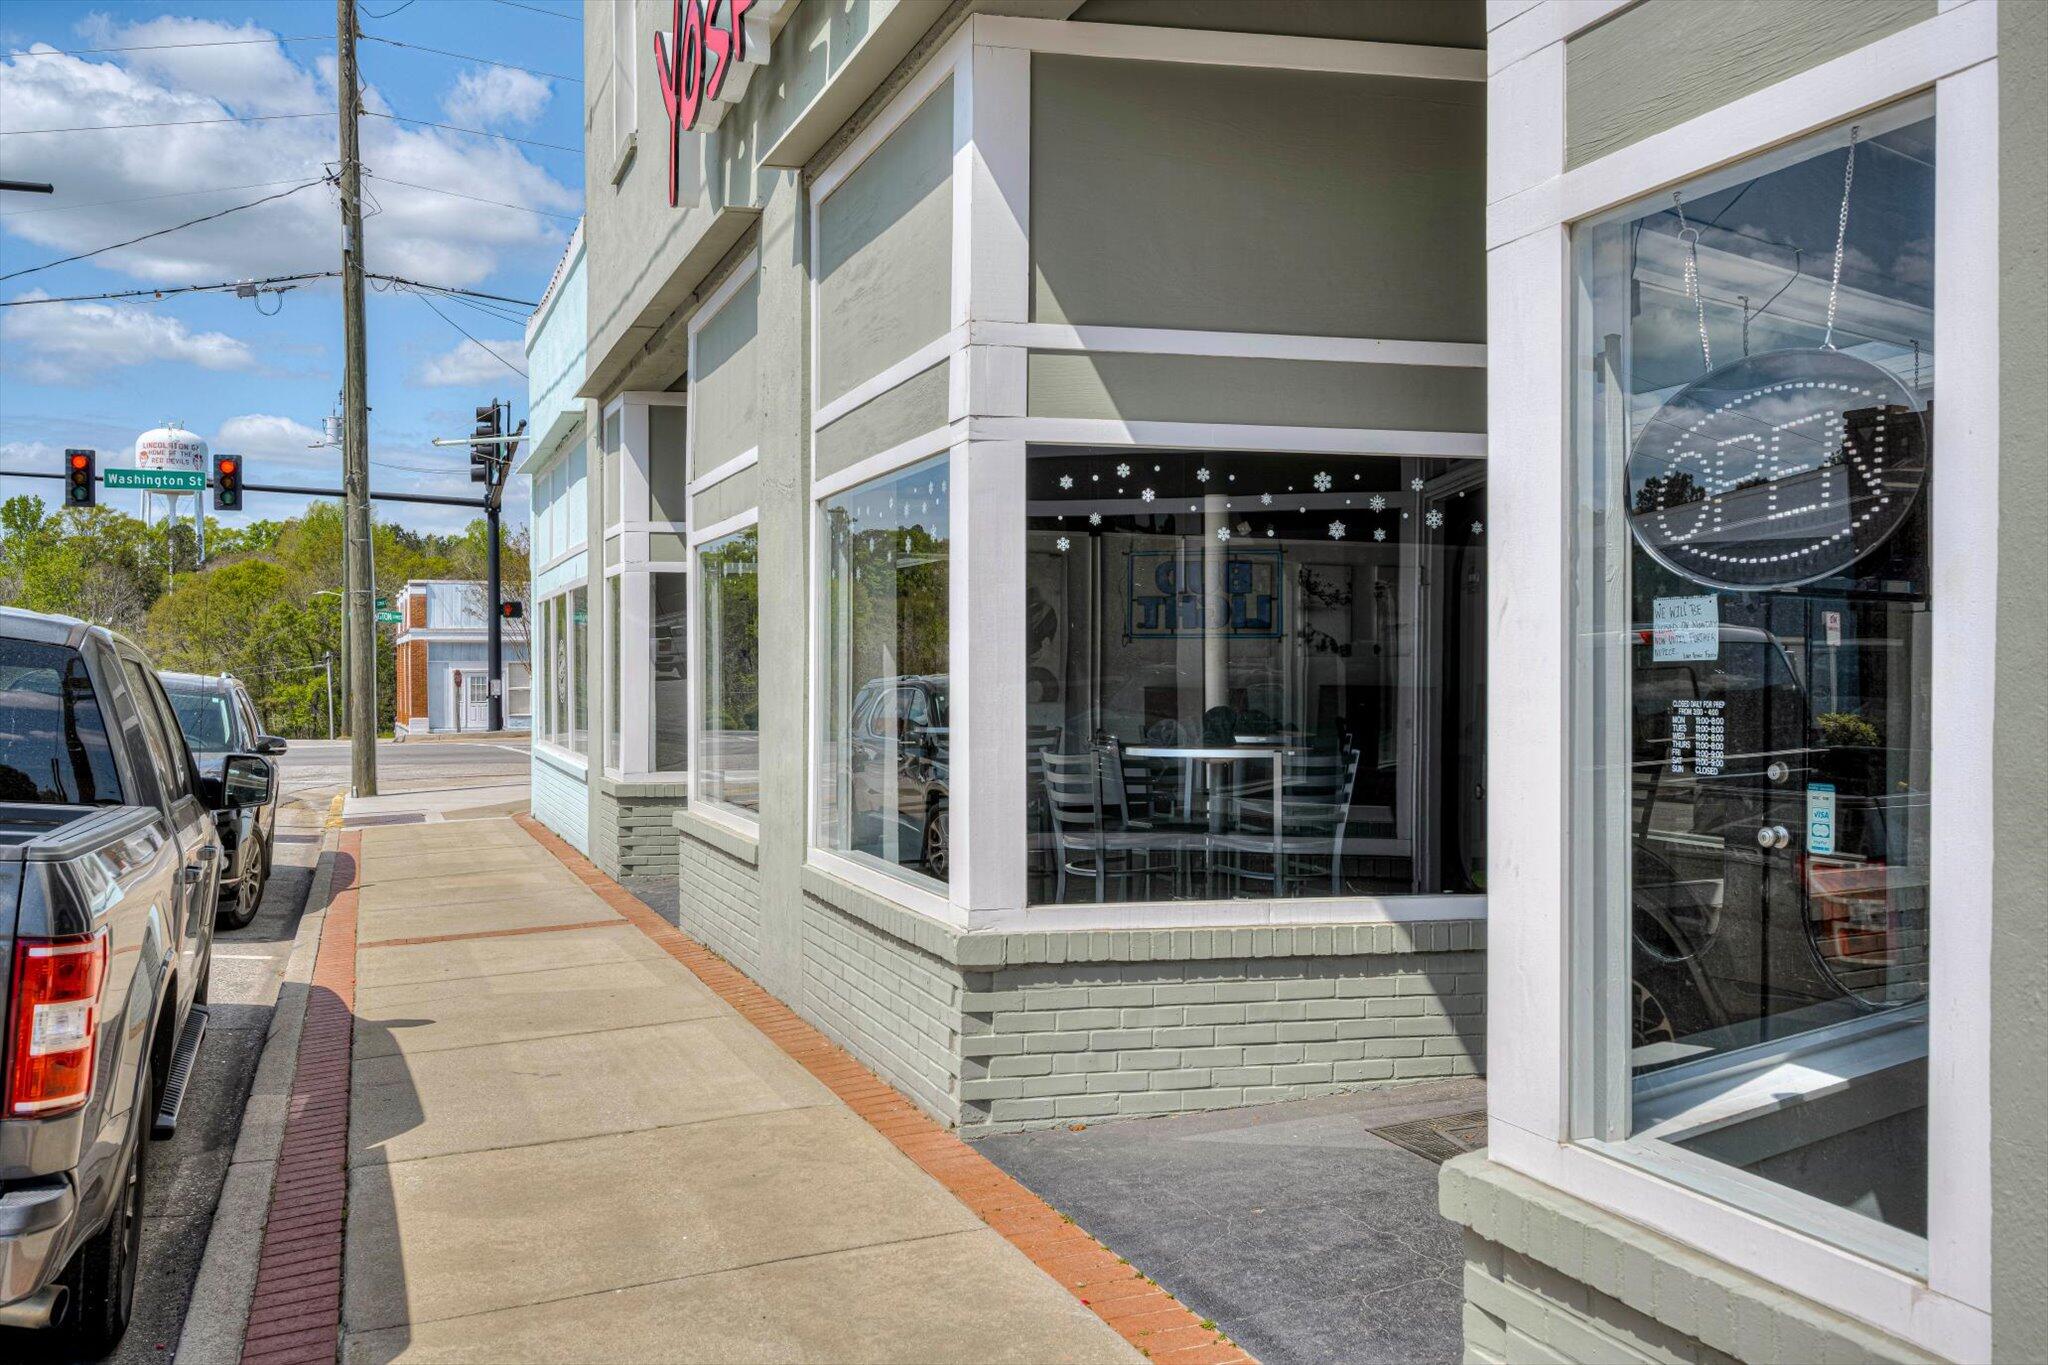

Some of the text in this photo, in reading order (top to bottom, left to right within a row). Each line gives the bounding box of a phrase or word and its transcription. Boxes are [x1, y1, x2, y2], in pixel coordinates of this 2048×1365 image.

[1657, 394, 1886, 541] OPEN
[108, 473, 202, 488] Washington St
[1655, 604, 1702, 619] WE WILL BE
[1672, 700, 1690, 708] CLOSED
[1691, 700, 1702, 708] DAILY
[1672, 724, 1687, 732] TUES
[1695, 767, 1718, 775] CLOSED
[1814, 811, 1829, 819] VISA
